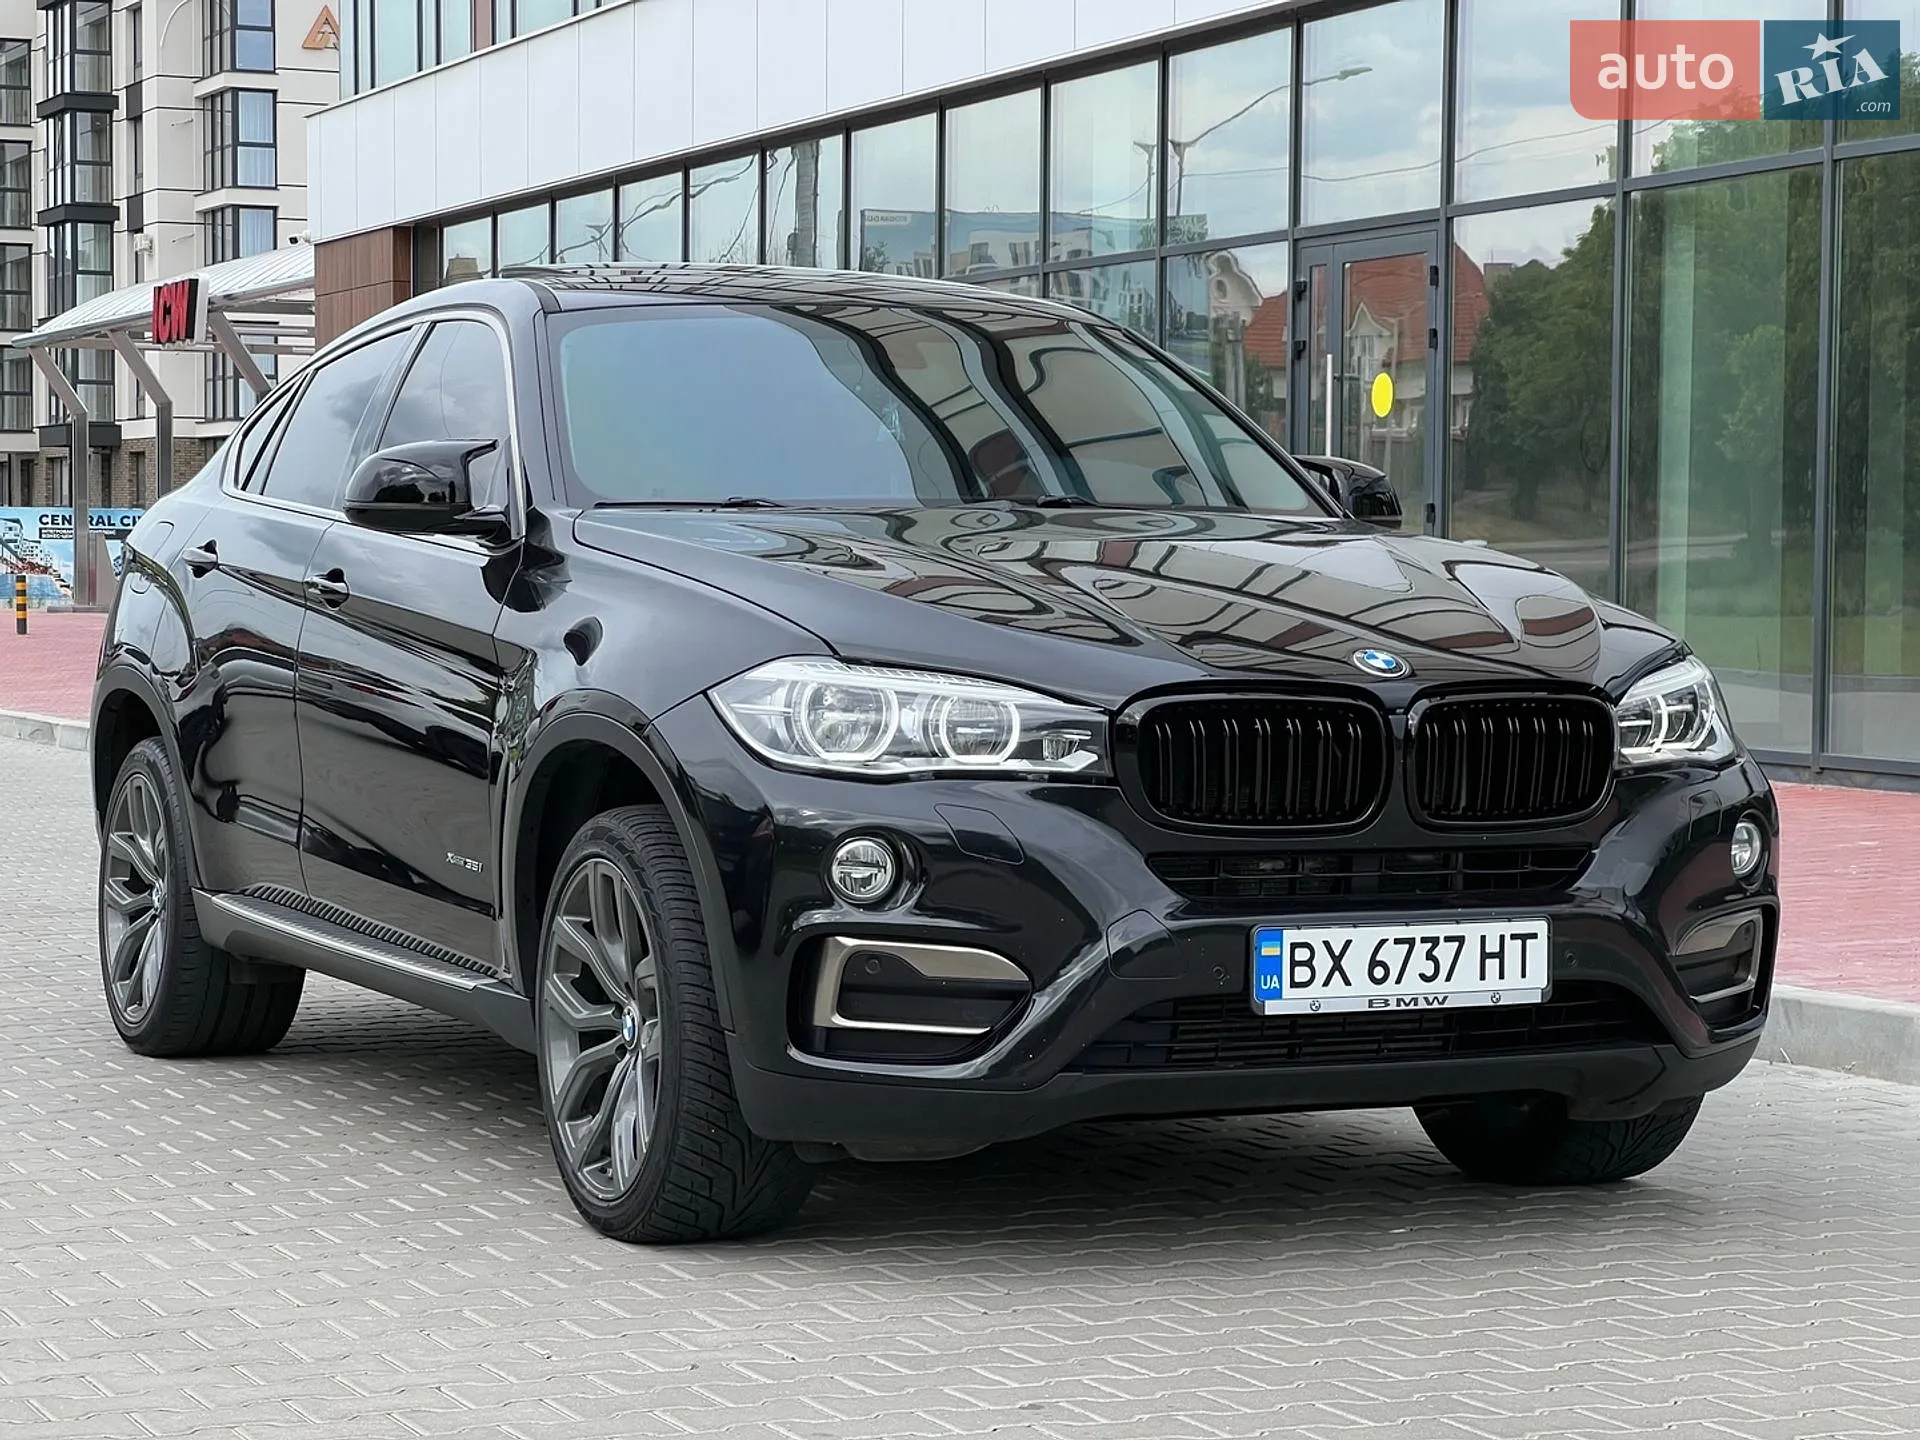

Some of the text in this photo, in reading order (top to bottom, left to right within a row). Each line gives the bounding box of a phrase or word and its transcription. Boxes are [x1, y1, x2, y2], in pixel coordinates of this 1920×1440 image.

[39, 514, 116, 527] CENRAL
[1289, 932, 1539, 989] BX 6737 HT
[1261, 974, 1280, 990] UA
[1367, 995, 1449, 1009] BMW
